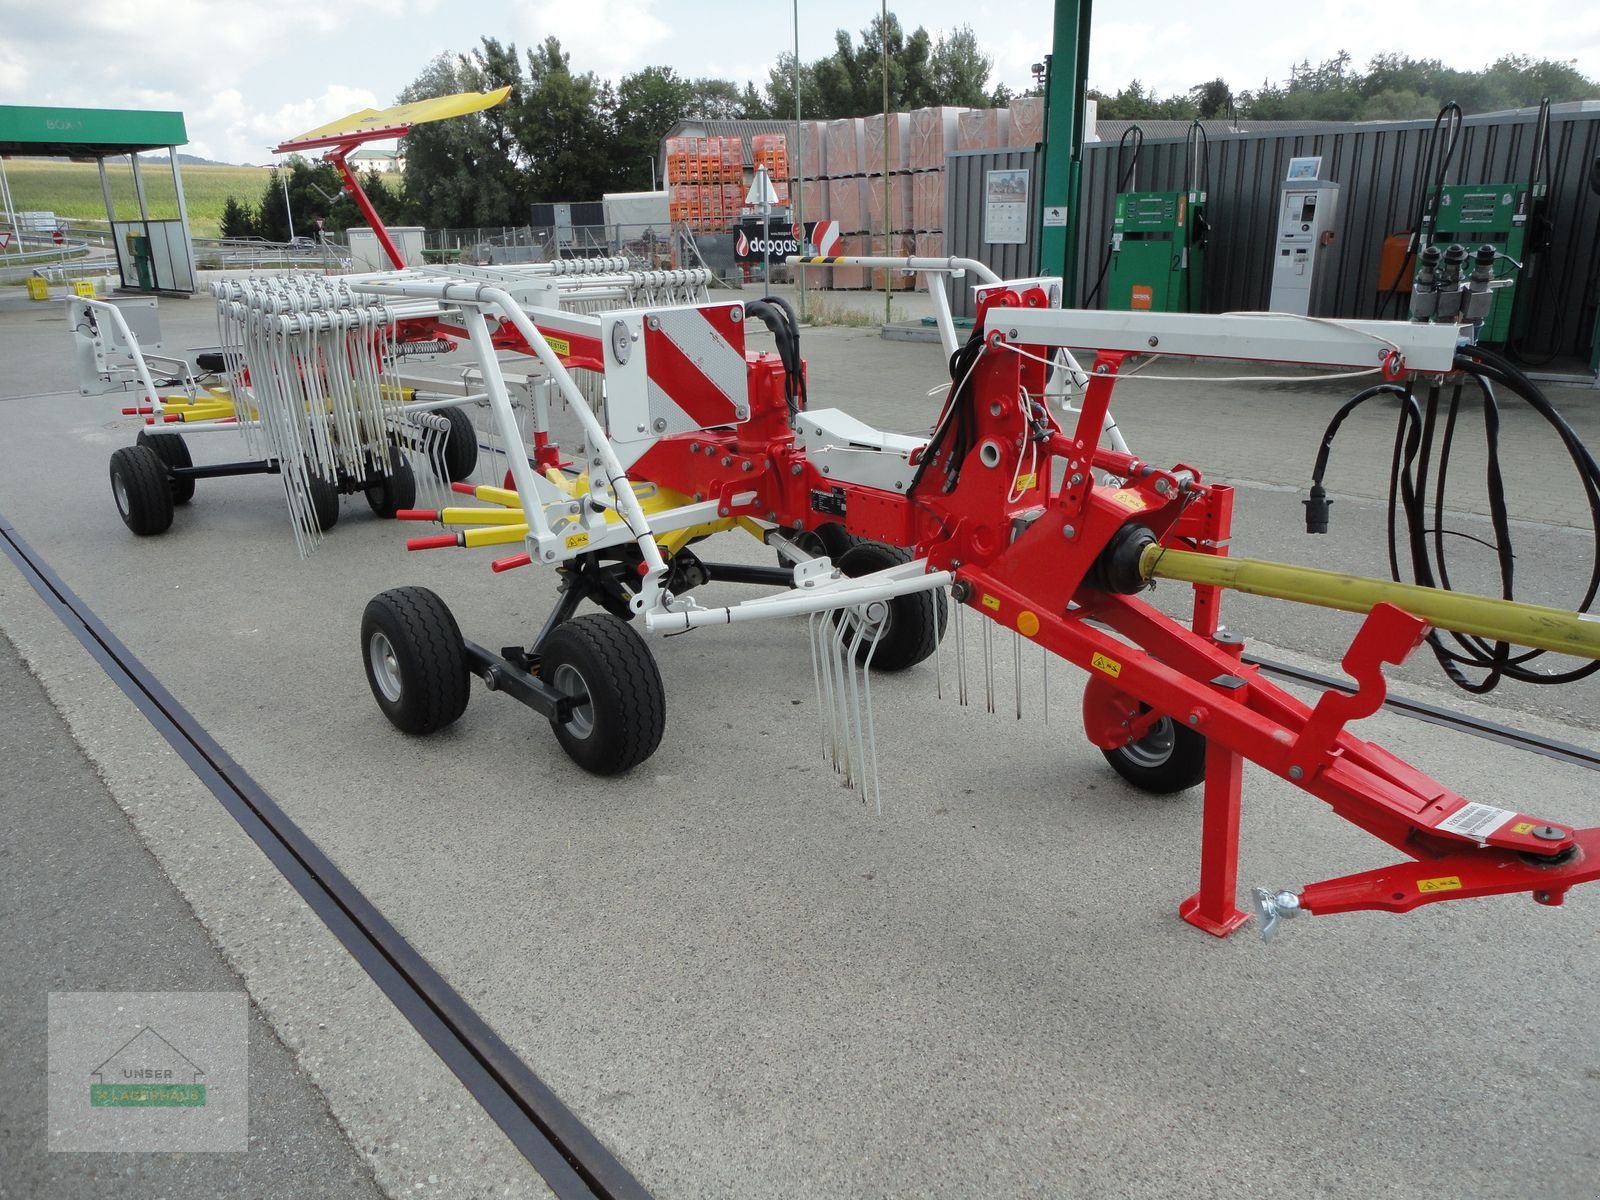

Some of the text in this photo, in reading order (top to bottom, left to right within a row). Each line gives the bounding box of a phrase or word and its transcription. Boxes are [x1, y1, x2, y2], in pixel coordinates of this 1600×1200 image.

[46, 119, 71, 130] BOX
[1113, 255, 1119, 272] 1
[1171, 254, 1181, 272] 2
